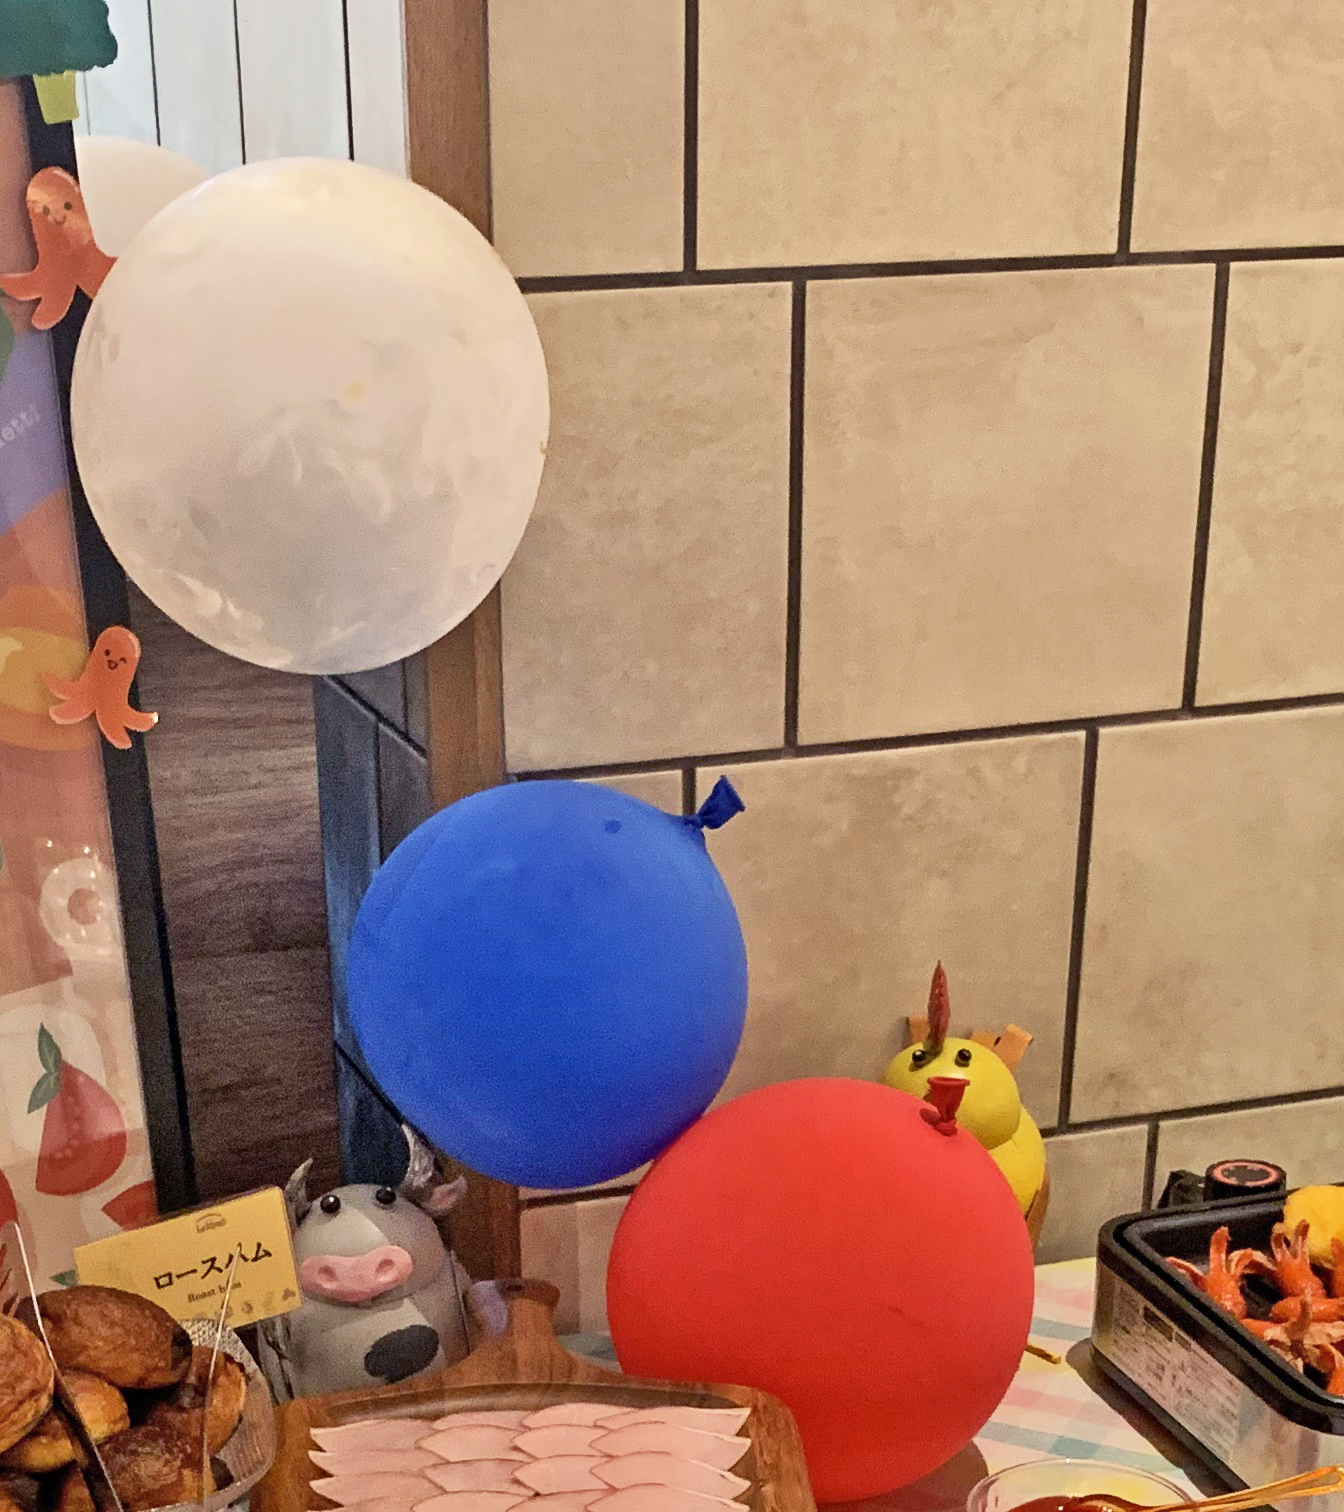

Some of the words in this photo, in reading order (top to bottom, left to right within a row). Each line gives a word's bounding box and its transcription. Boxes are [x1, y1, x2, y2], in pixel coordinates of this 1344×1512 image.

[153, 1241, 273, 1290] ロースハム
